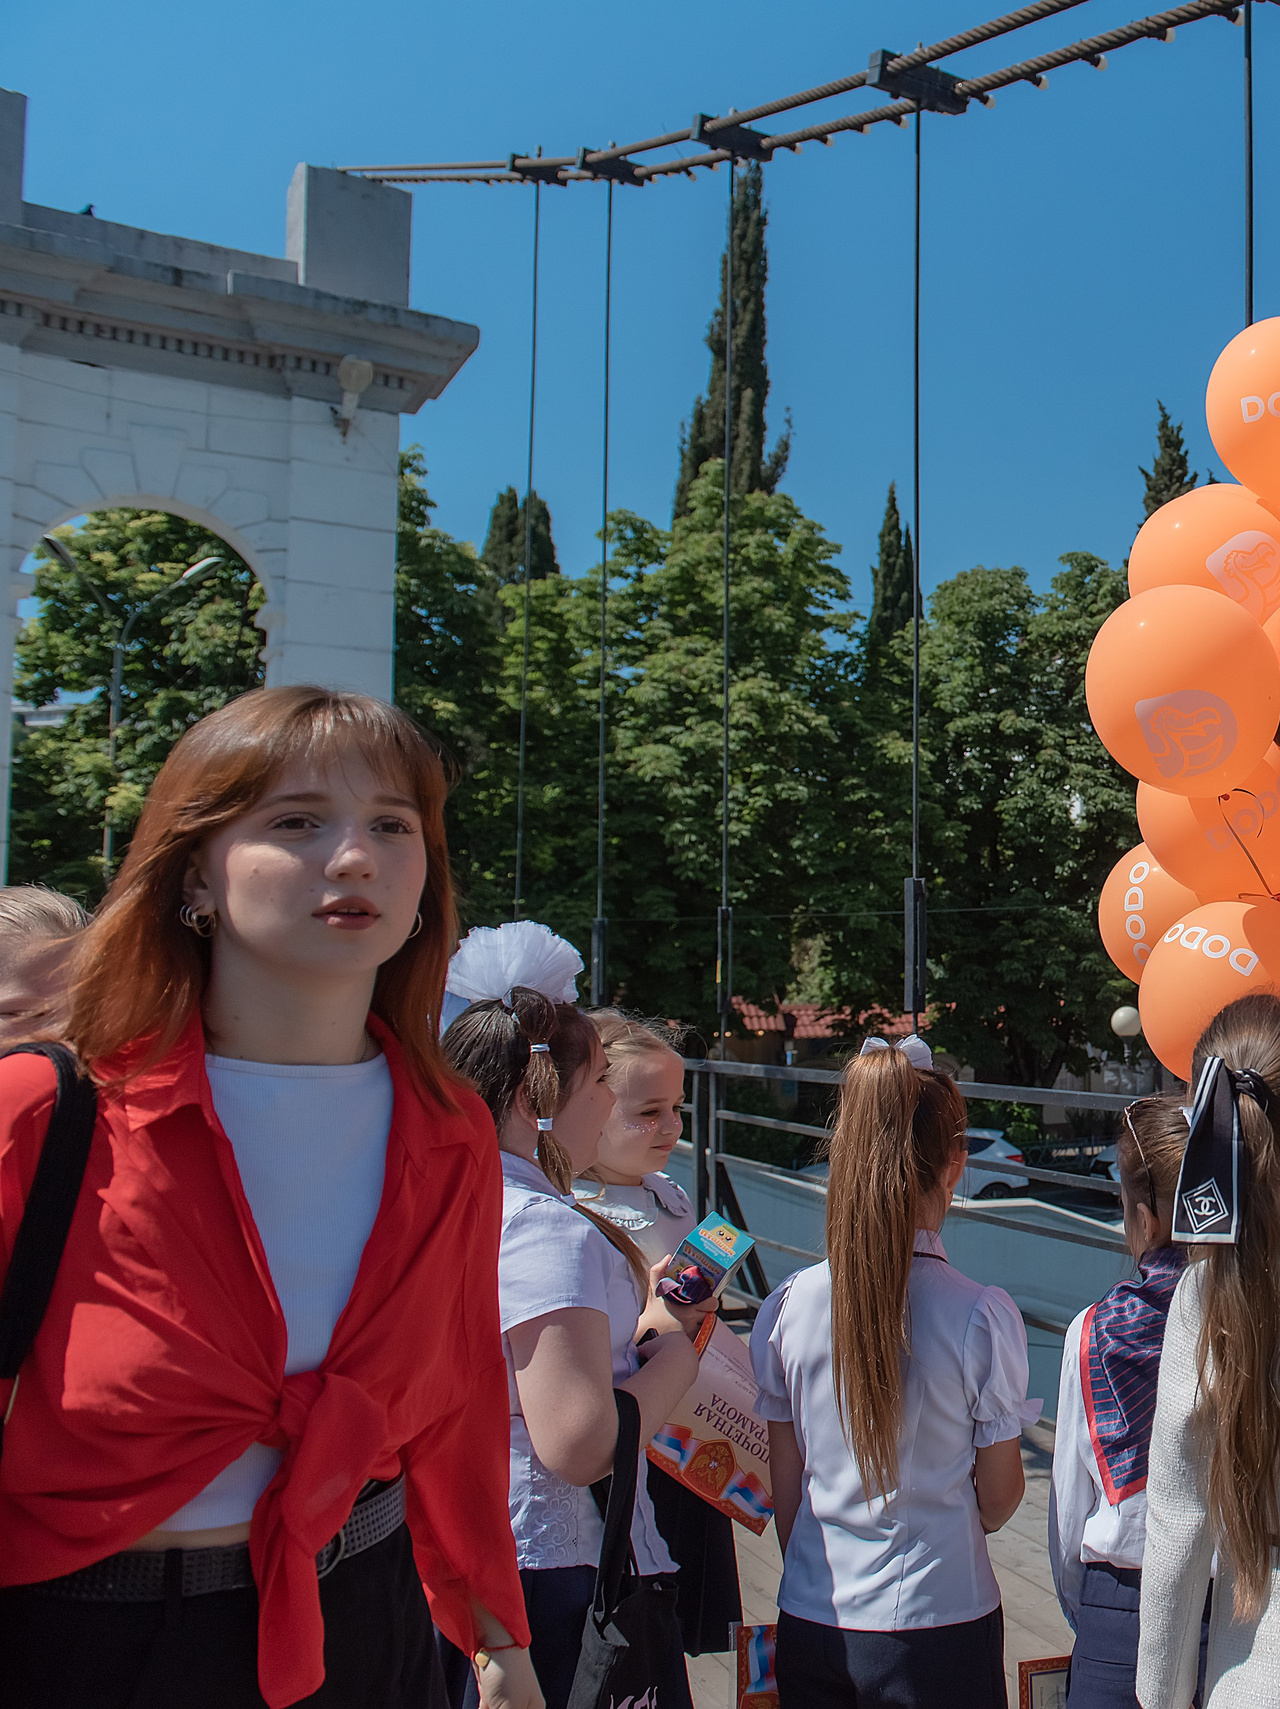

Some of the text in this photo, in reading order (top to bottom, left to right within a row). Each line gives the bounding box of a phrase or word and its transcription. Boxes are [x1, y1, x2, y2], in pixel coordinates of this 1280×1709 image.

[1123, 861, 1151, 966] DODO
[1163, 923, 1260, 977] DODO
[693, 1402, 770, 1465] ПОЧЕТНАЯ
